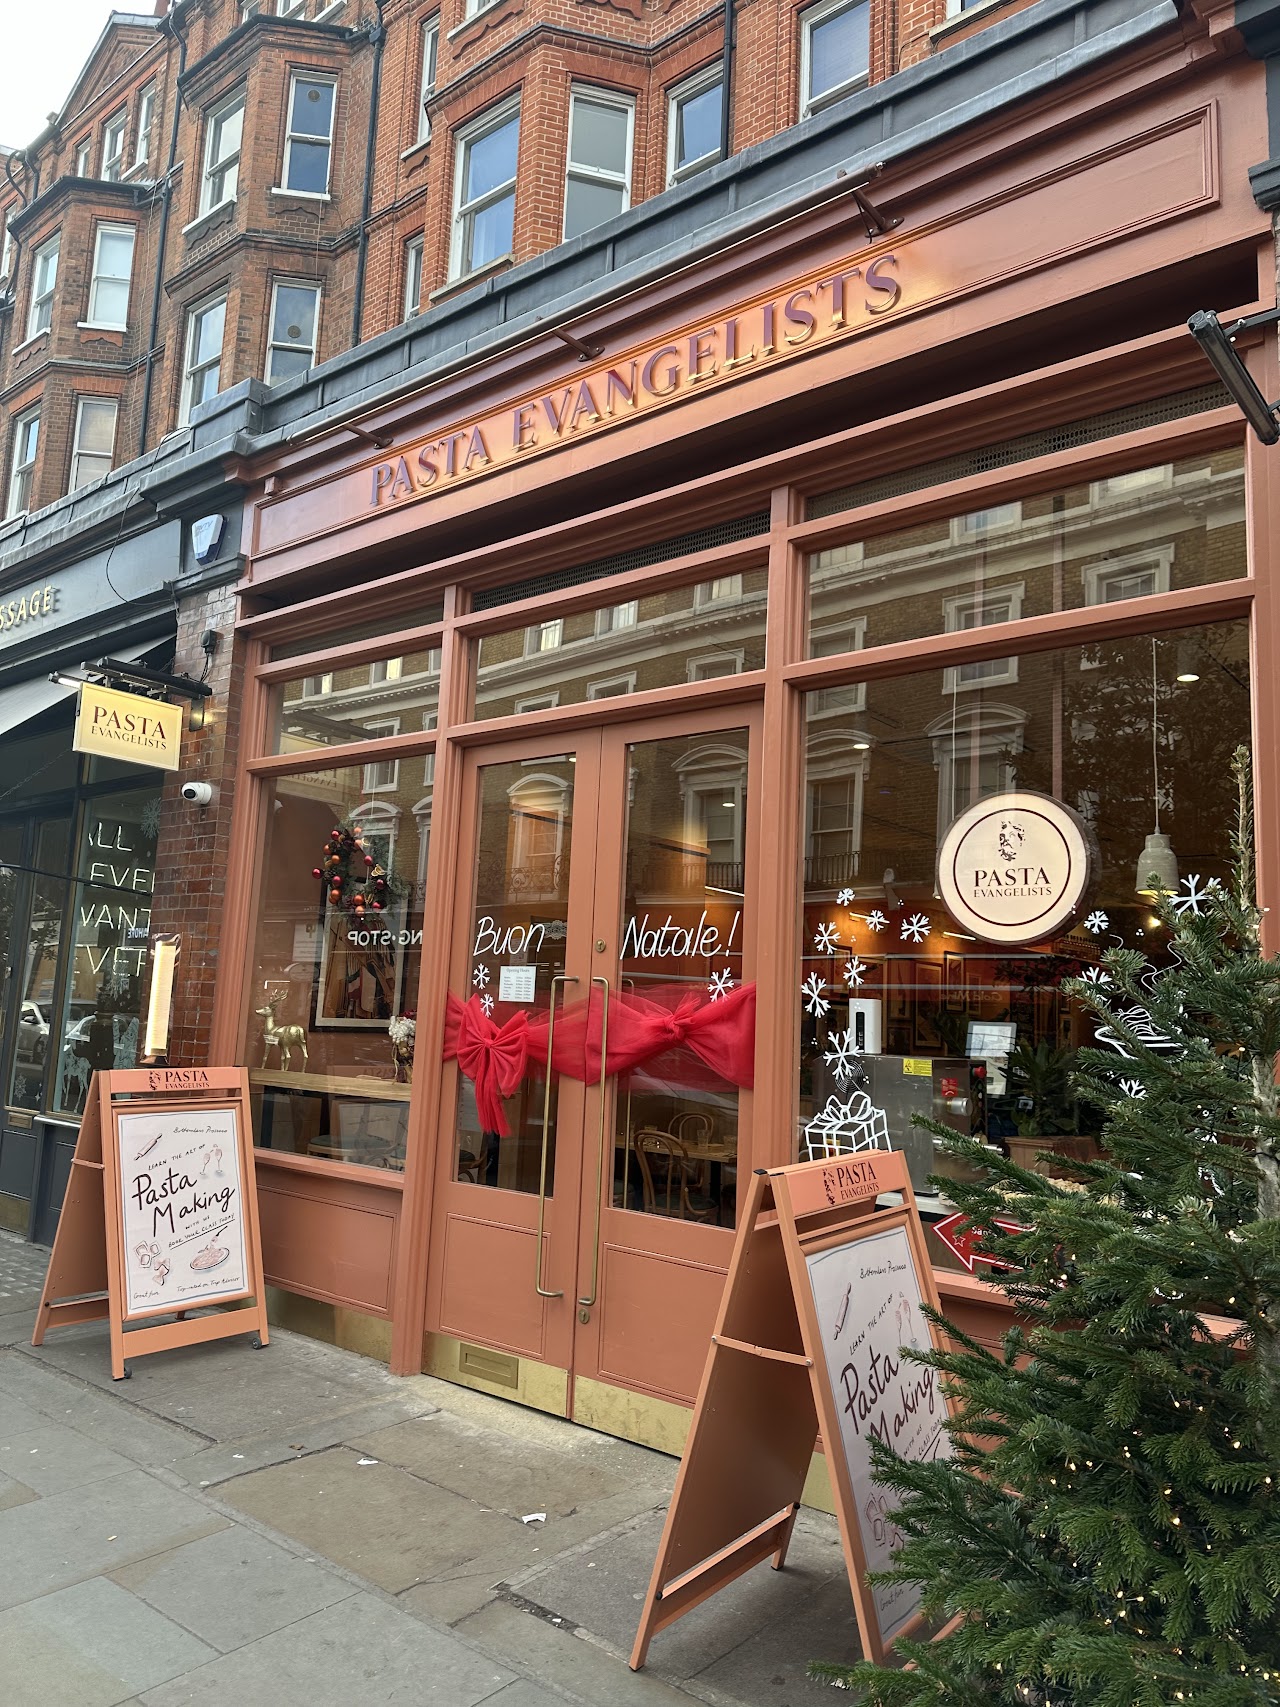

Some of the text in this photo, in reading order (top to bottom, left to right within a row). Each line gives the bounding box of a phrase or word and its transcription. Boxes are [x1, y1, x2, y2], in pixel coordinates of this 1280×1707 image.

[368, 253, 902, 507] PASTA EVANGELISTS
[91, 725, 167, 750] EVANGELISTS
[93, 706, 166, 739] PASTA
[973, 887, 1052, 898] EVANGELISTS
[974, 867, 1051, 887] PASTA
[472, 910, 741, 960] Buon Natale!
[165, 1070, 208, 1082] PASTA
[148, 1160, 167, 1170] LEARN
[171, 1153, 182, 1161] THE
[185, 1148, 197, 1156] ART
[836, 1161, 877, 1187] PASTA
[131, 1167, 197, 1211] Pasta
[840, 1182, 880, 1200] EVANGELISTS
[153, 1187, 236, 1238] Making
[185, 1221, 200, 1230] WITH
[168, 1213, 235, 1248] BOOK YOUR CLASS TODAY
[849, 1330, 865, 1356] LEARN
[867, 1316, 877, 1331] THE
[878, 1302, 887, 1319] ART
[840, 1345, 899, 1435] Pasta
[870, 1367, 934, 1452] Making
